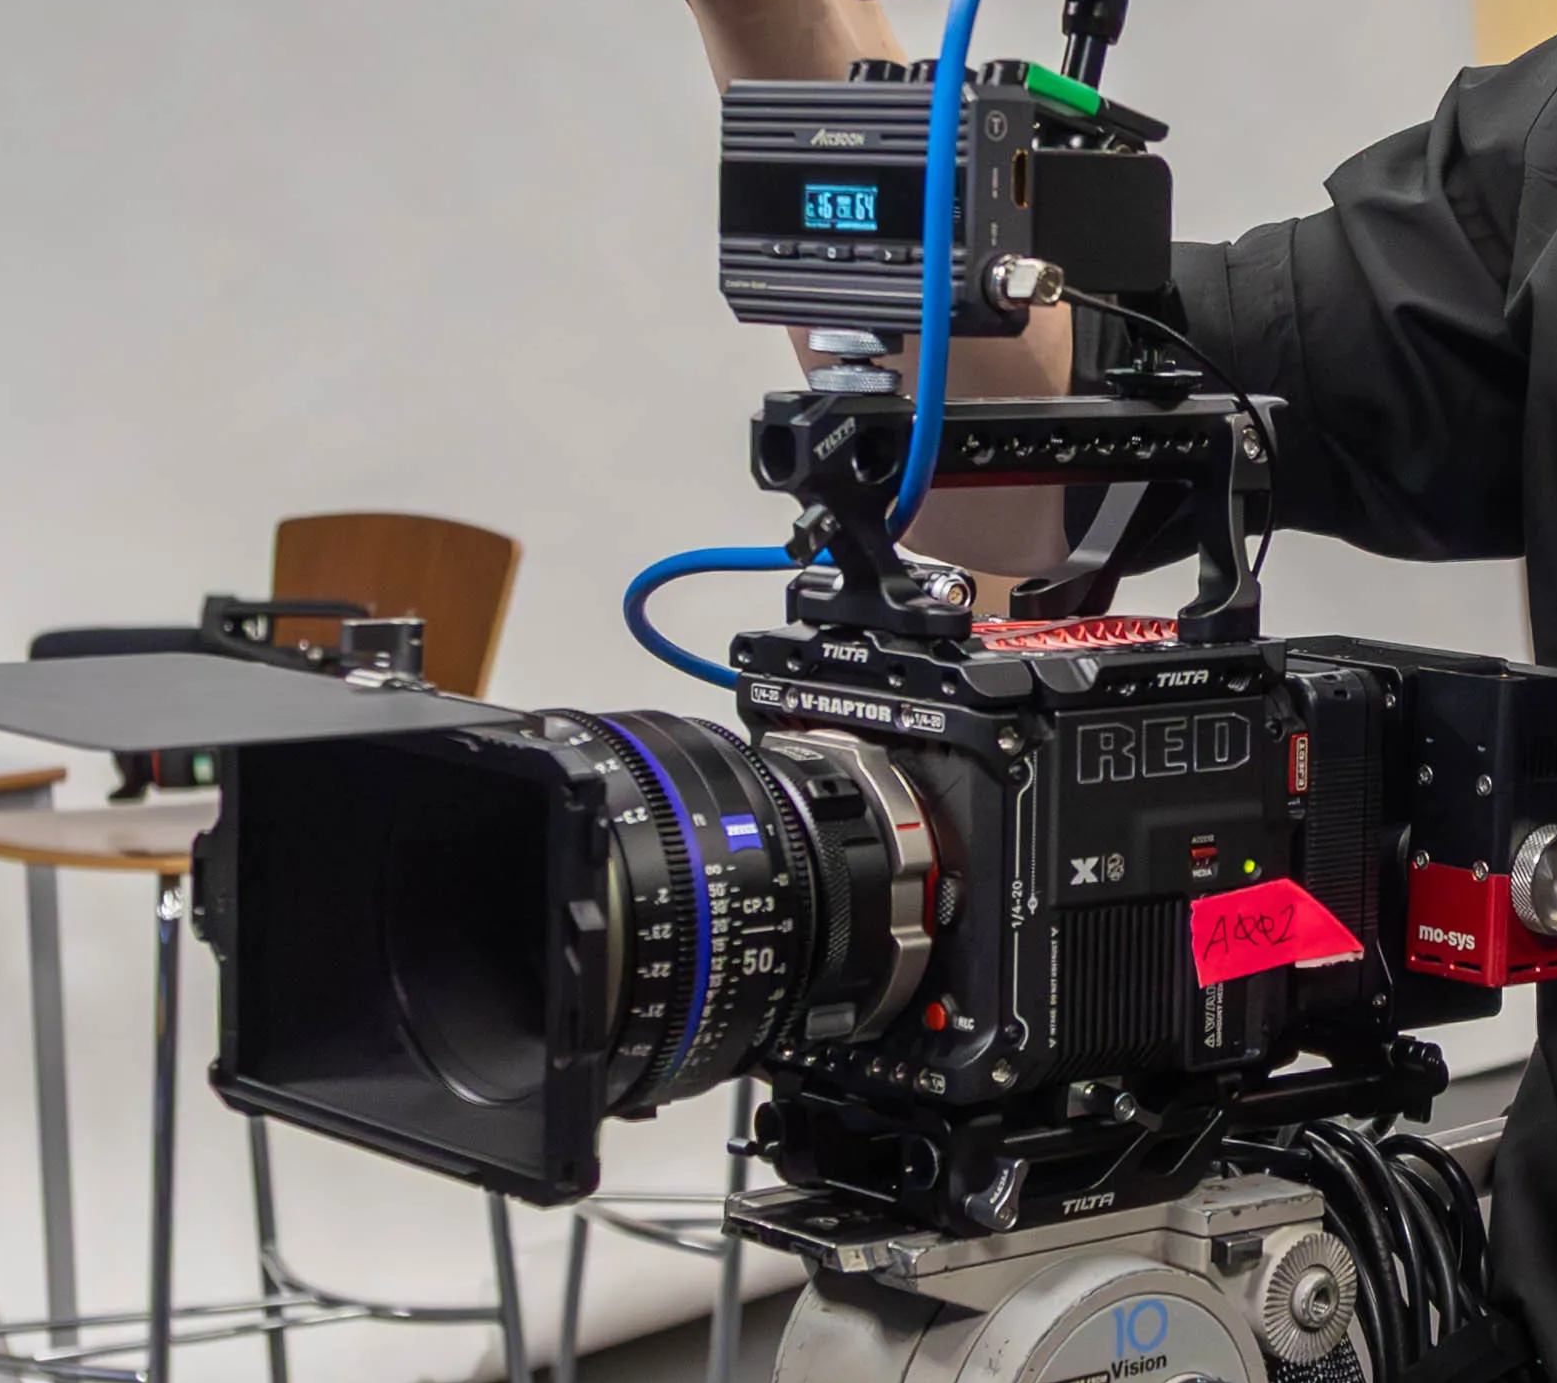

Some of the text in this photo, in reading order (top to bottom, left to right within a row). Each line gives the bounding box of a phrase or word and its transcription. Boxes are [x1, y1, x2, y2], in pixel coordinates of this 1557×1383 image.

[822, 643, 869, 663] TILTA
[1156, 669, 1209, 687] TILTA
[800, 692, 892, 722] V-RAPTOR
[1077, 712, 1251, 784] RED
[743, 896, 775, 914] CP.3
[1011, 880, 1025, 928] 1/4-20
[742, 947, 774, 976] 50
[1062, 1192, 1115, 1215] TILTA
[1112, 1299, 1169, 1359] 10
[1111, 1354, 1168, 1380] Vision
